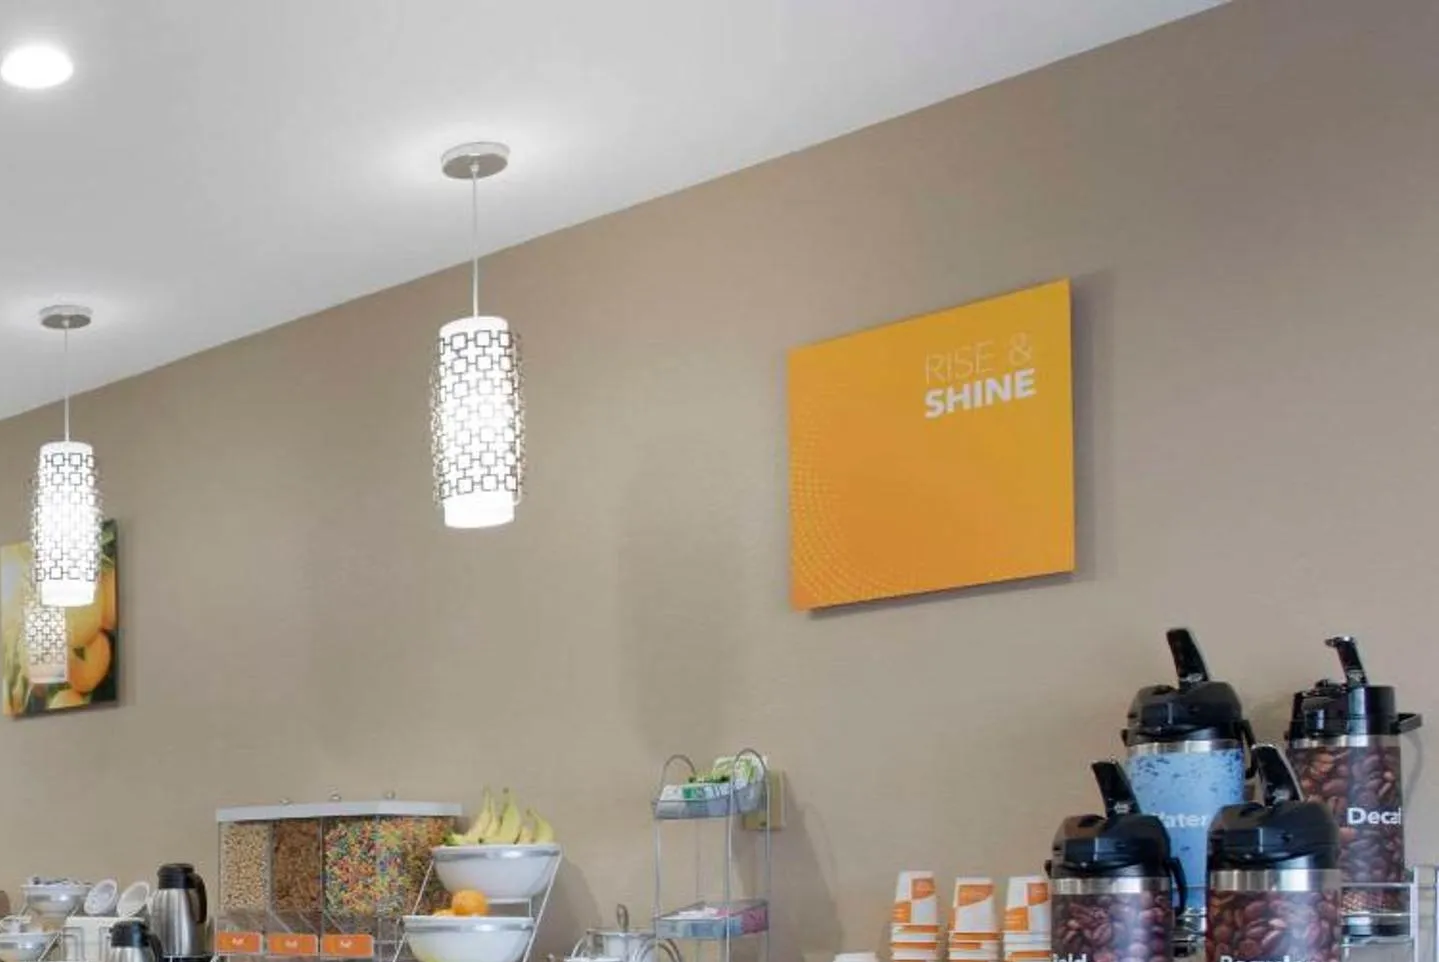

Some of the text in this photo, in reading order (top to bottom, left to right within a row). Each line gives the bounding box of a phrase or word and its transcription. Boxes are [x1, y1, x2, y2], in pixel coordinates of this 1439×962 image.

[925, 332, 1032, 384] RISE &
[924, 368, 1037, 419] SHINE
